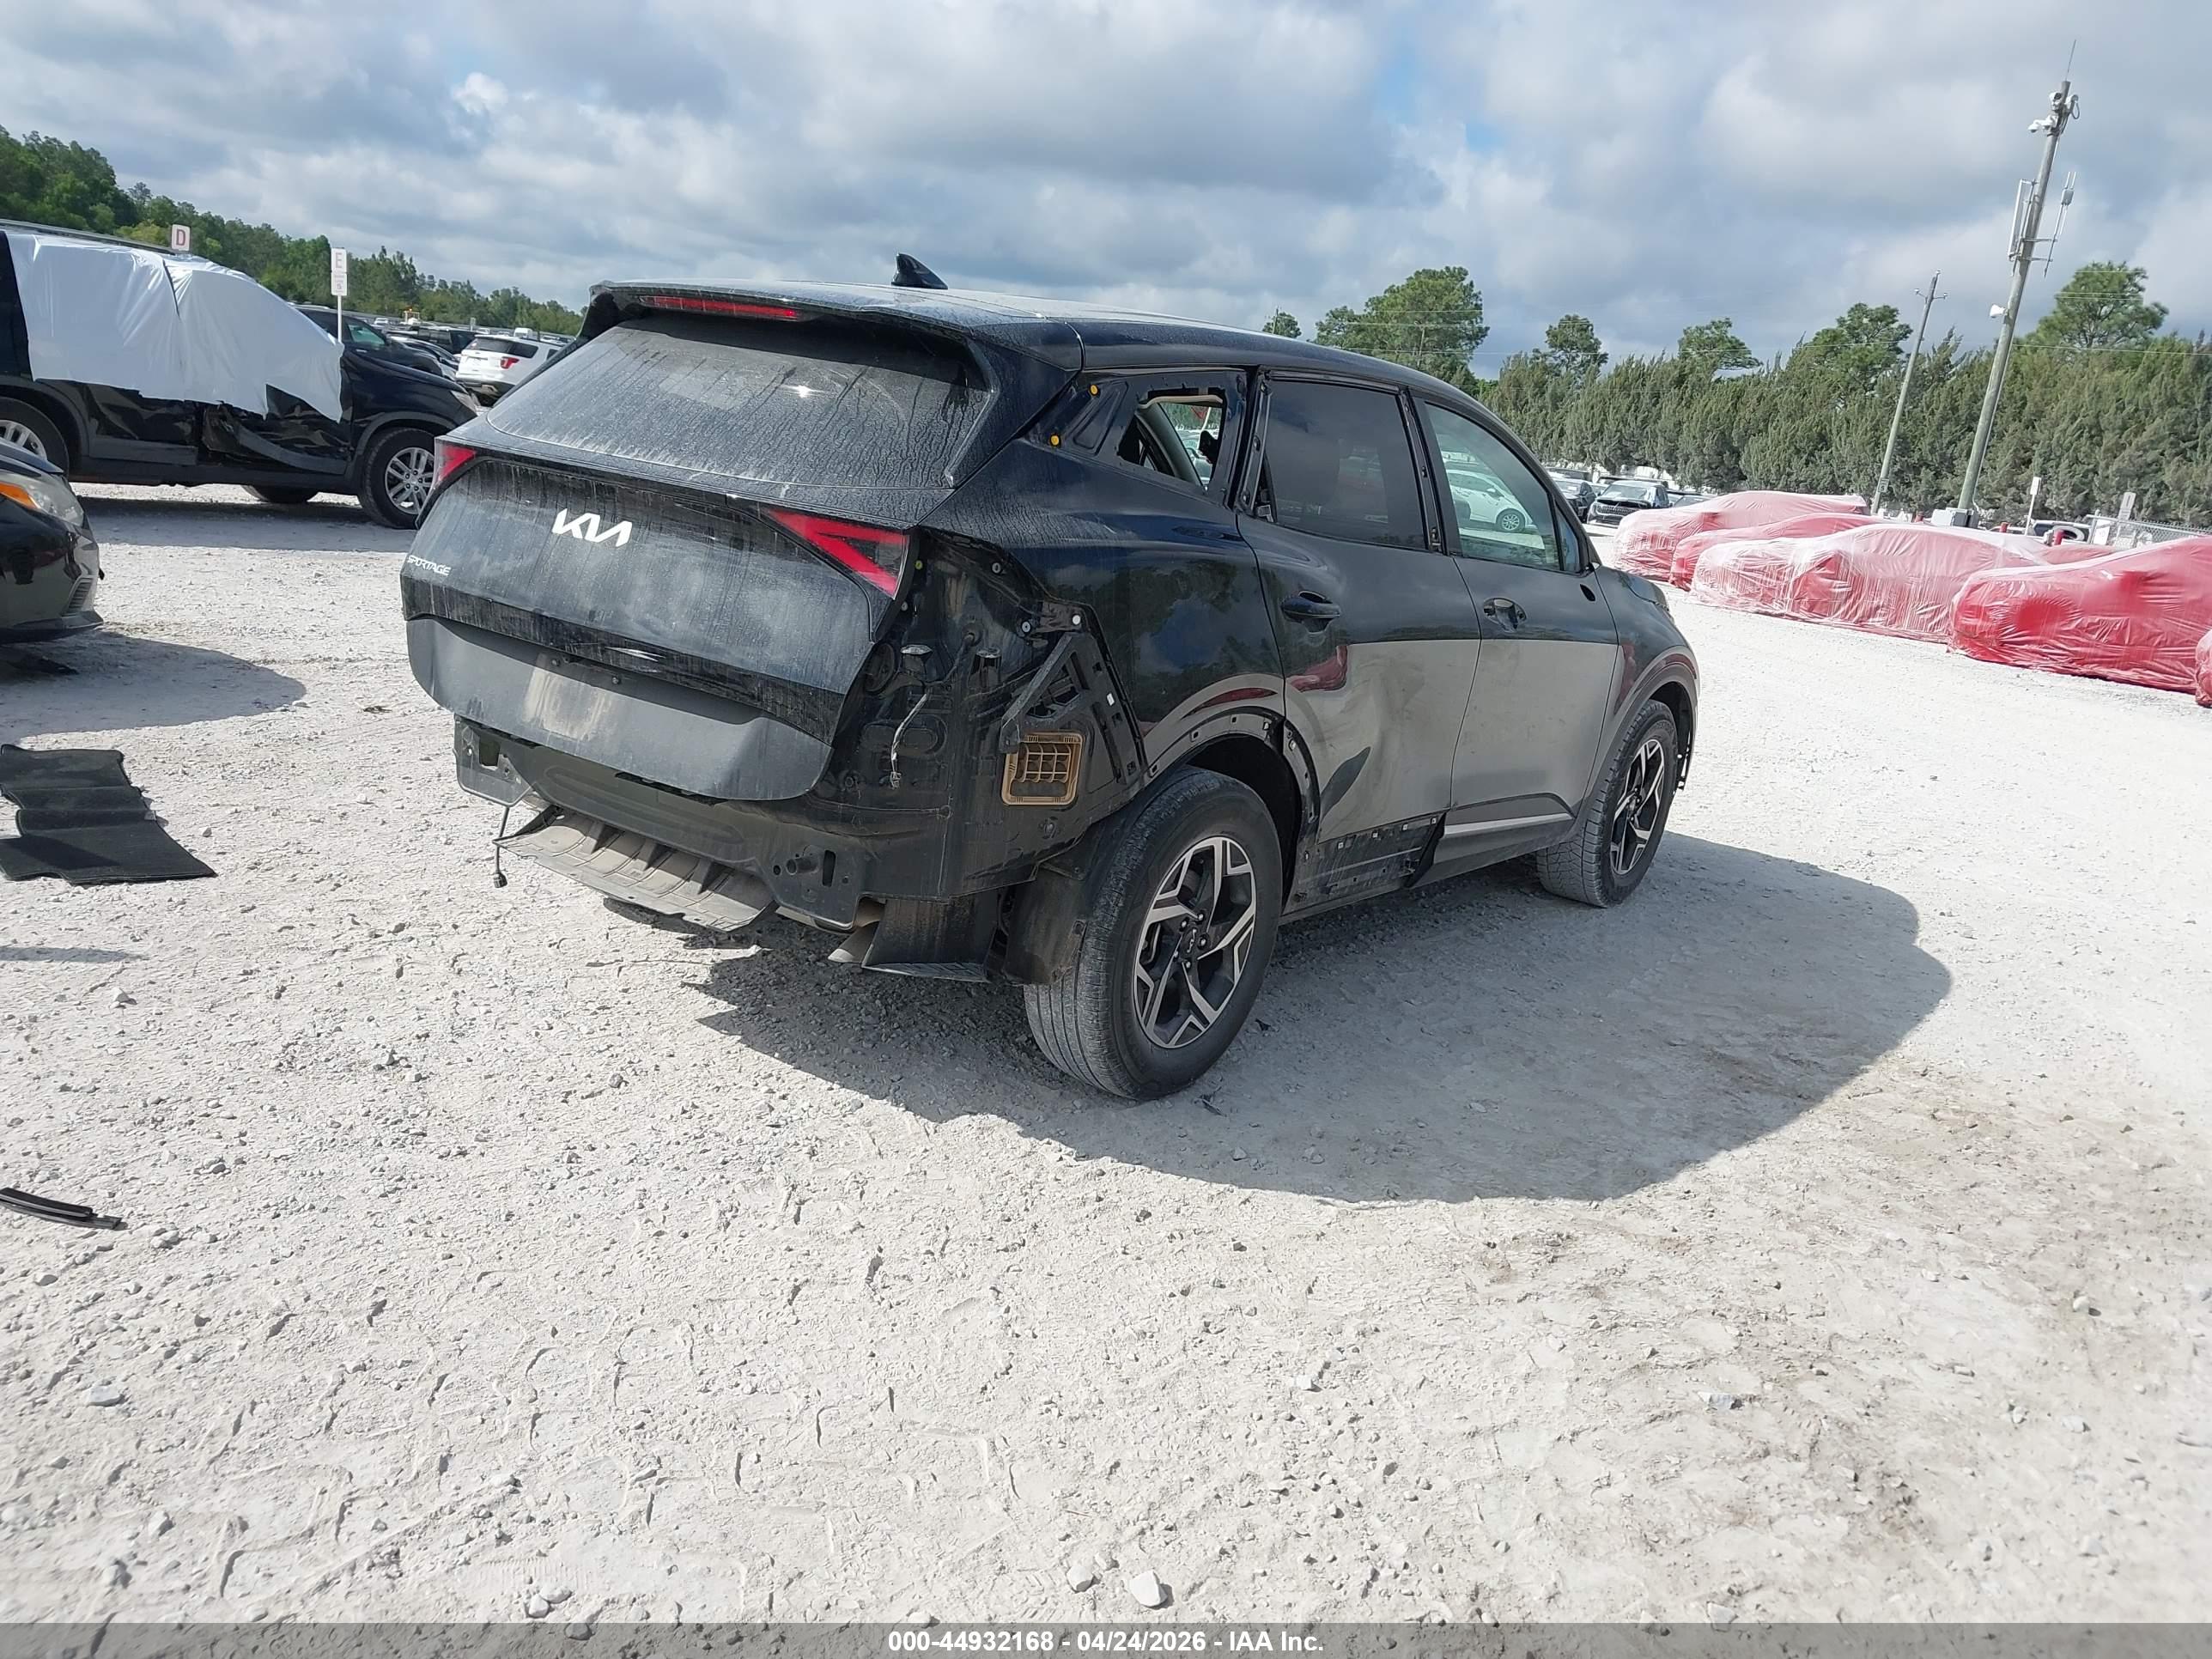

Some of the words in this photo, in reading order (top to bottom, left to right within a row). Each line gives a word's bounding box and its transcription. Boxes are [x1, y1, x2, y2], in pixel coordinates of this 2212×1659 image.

[176, 228, 186, 246] D
[335, 252, 343, 269] E
[551, 507, 633, 547] KIA
[407, 554, 452, 576] SPORTAGE
